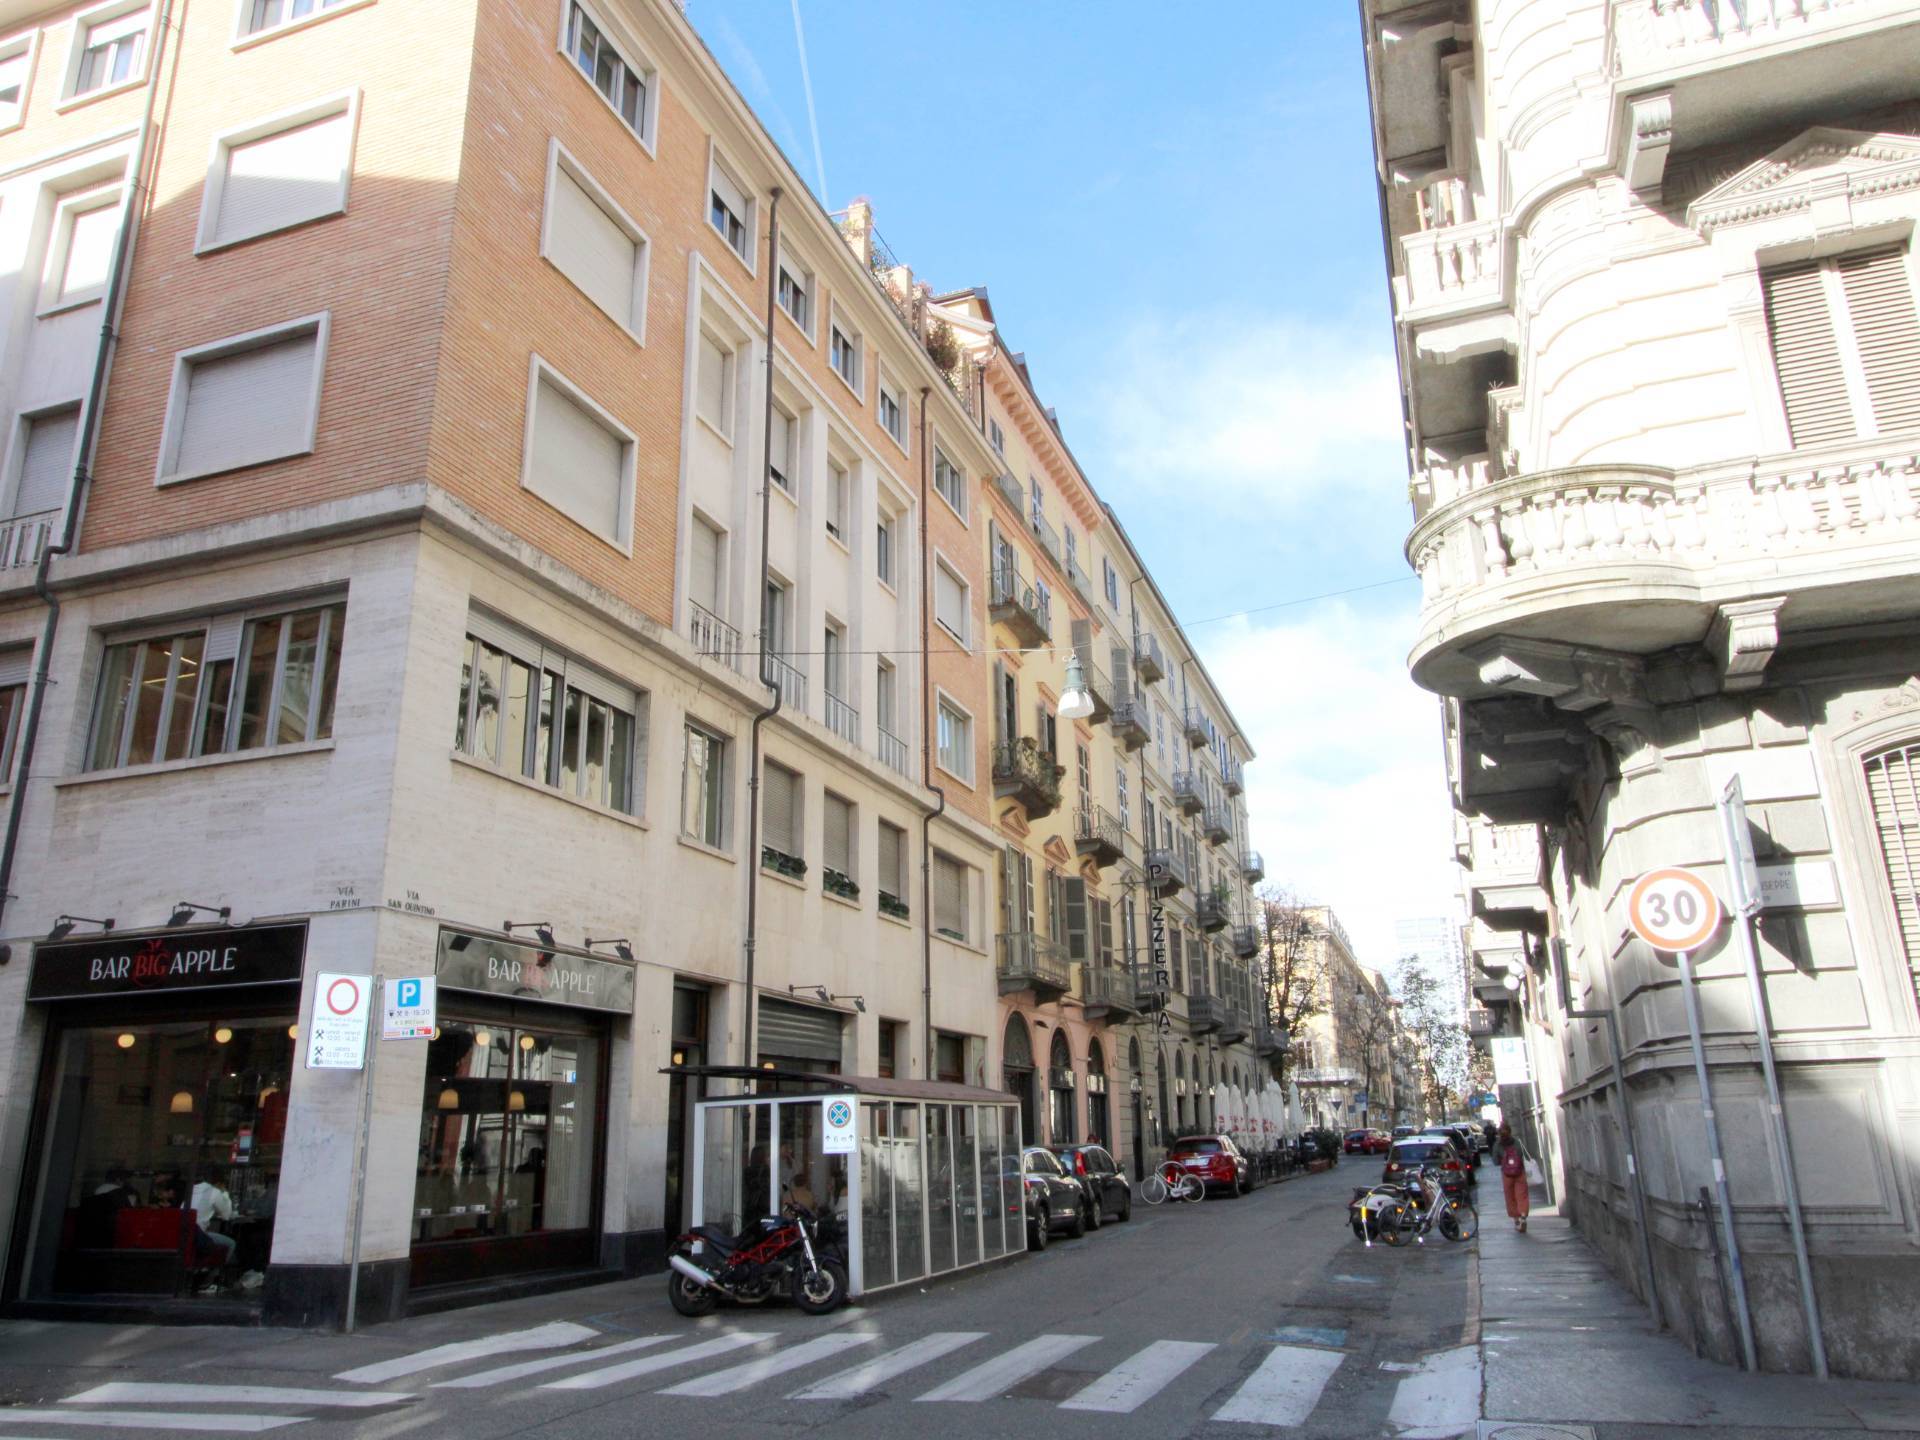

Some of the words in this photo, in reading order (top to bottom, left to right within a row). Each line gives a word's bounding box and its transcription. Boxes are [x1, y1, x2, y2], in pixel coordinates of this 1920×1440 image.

[338, 887, 354, 896] VIA
[407, 889, 420, 900] VIA
[330, 898, 361, 910] PARINI
[387, 898, 402, 910] SAN
[404, 902, 436, 916] QUINTINO
[1647, 890, 1697, 928] 30
[1150, 864, 1171, 1028] PIZZERIA
[90, 956, 131, 981] BAR
[135, 953, 168, 977] BIG
[168, 947, 238, 975] APPLE
[488, 957, 521, 983] BAR
[550, 968, 596, 994] APPLE
[402, 982, 417, 1004] P
